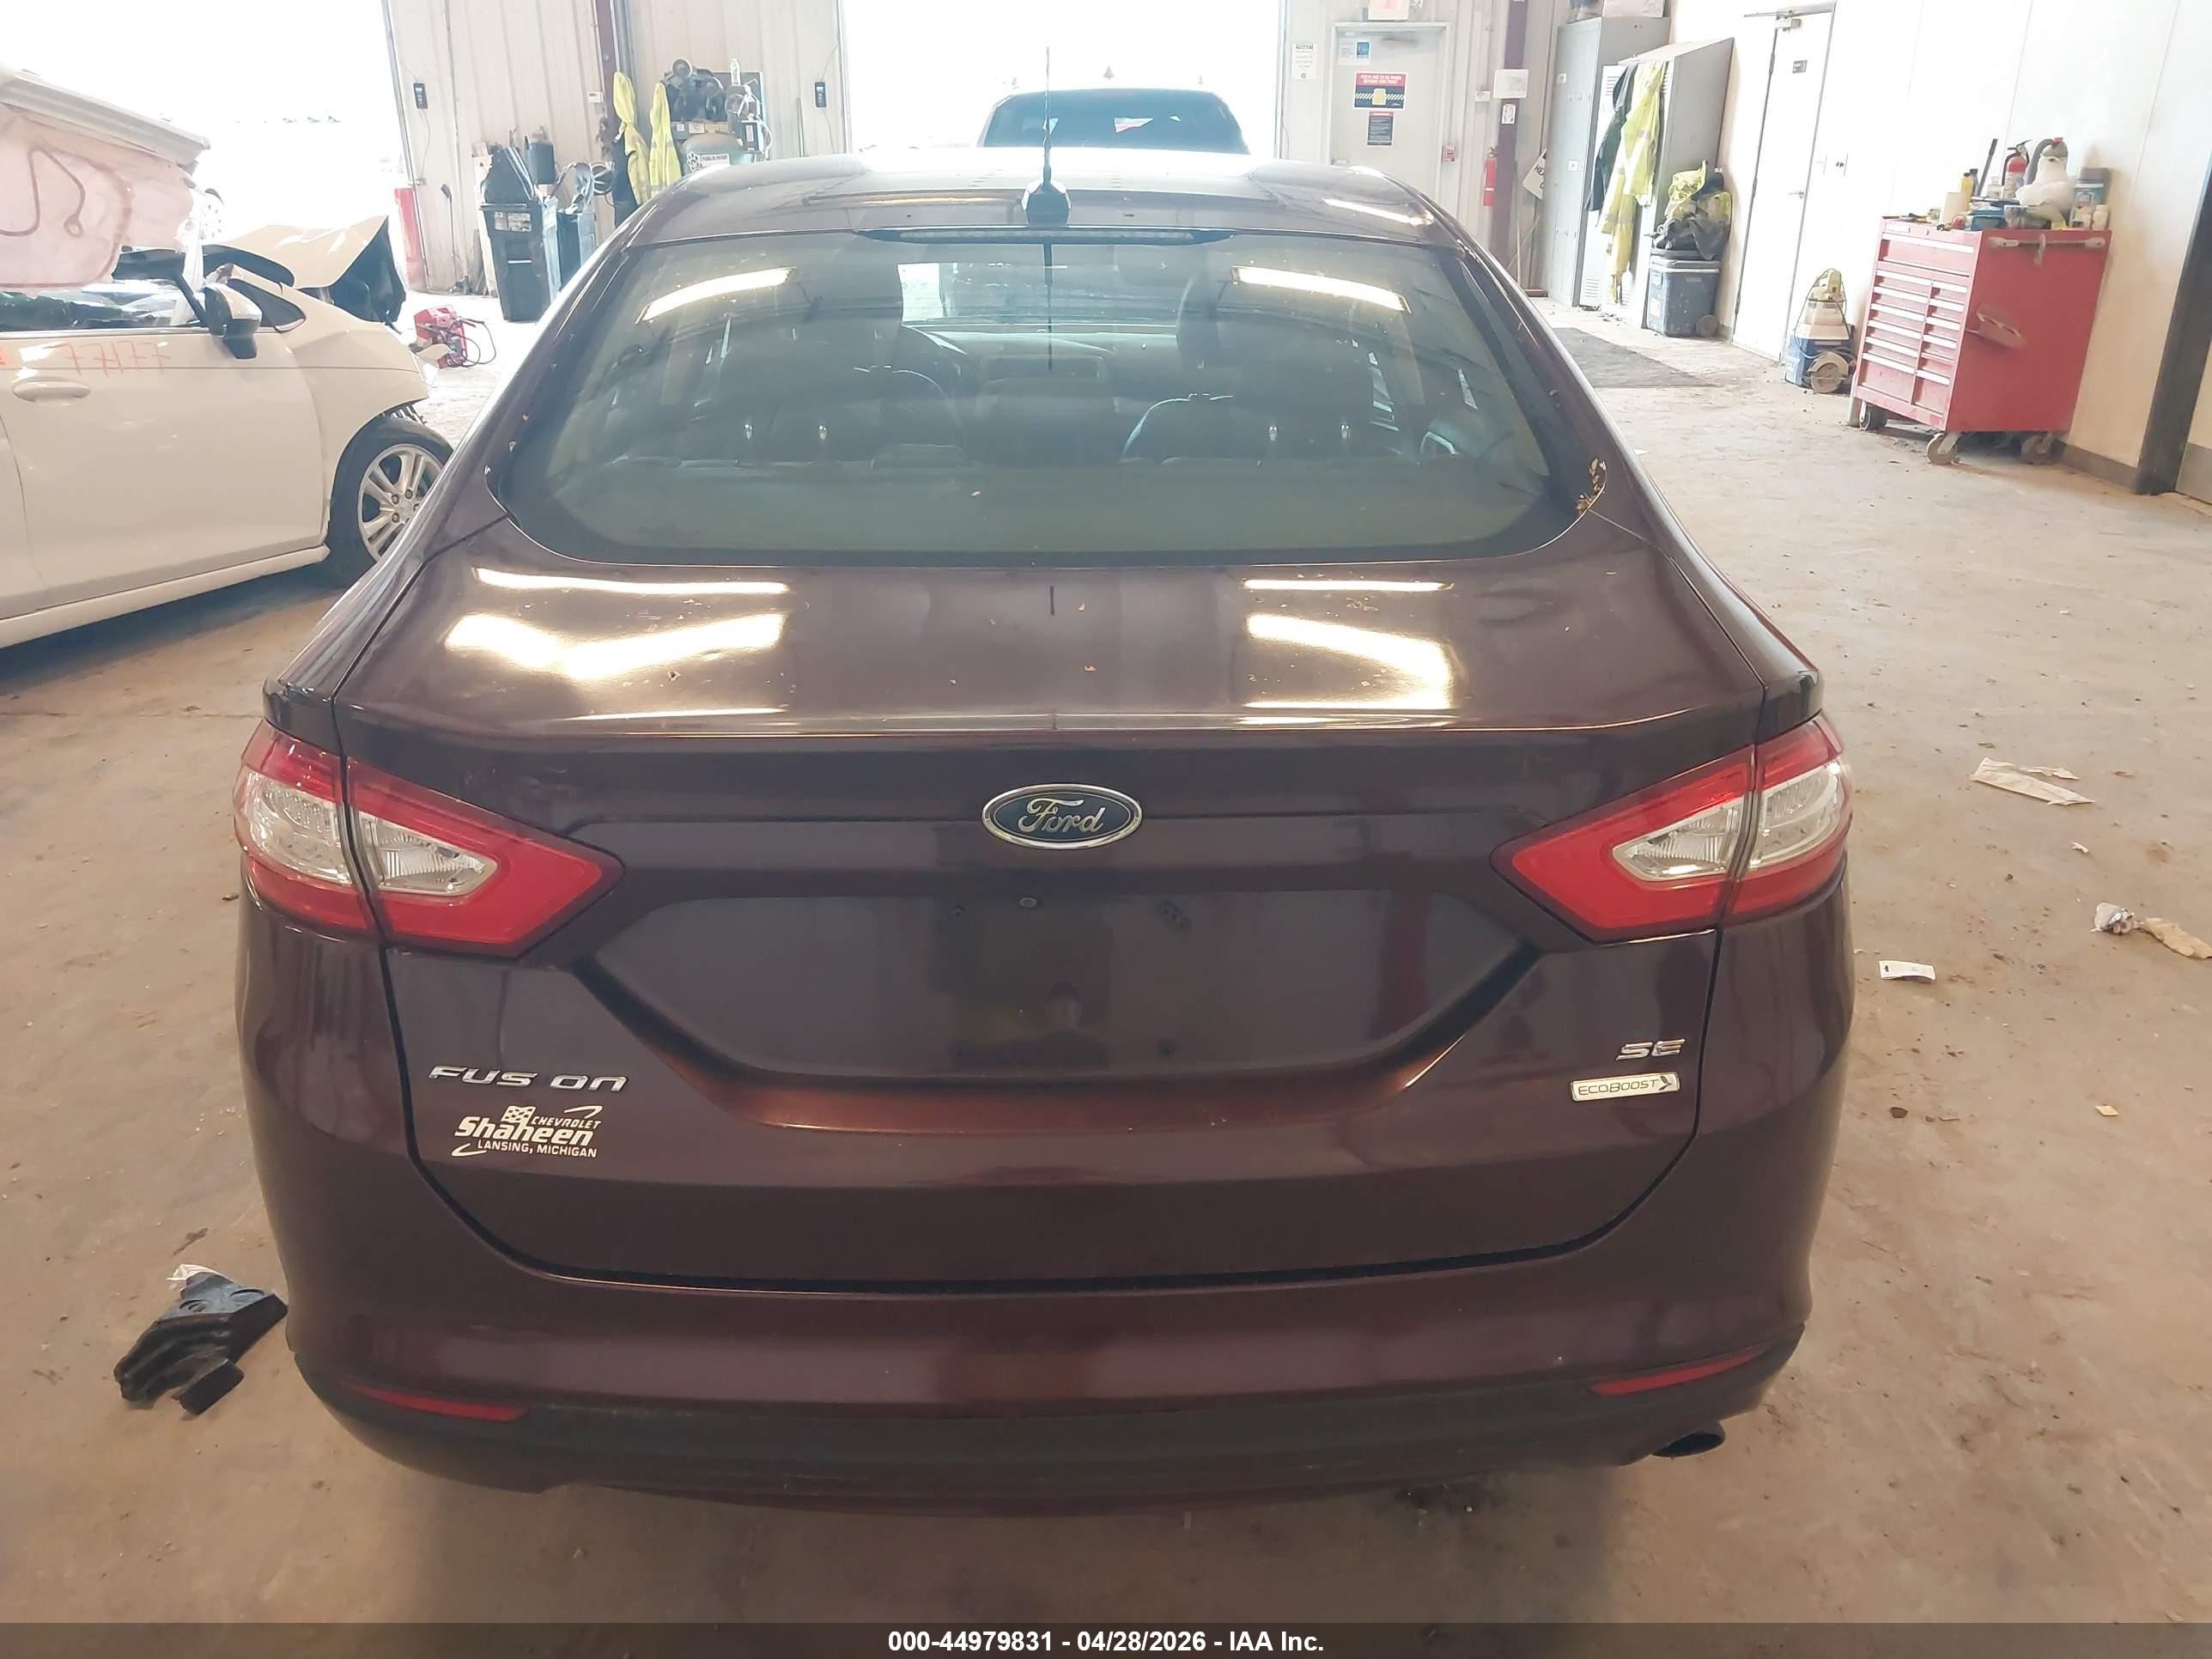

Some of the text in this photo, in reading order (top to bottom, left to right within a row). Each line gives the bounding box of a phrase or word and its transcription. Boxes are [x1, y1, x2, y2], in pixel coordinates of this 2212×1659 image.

[1018, 797, 1106, 832] Ford
[1614, 1037, 1686, 1061] SE
[454, 1115, 594, 1146] Shaheen
[532, 1115, 602, 1130] CHEVROLET
[477, 1139, 598, 1158] LANSING, MICHIGAN
